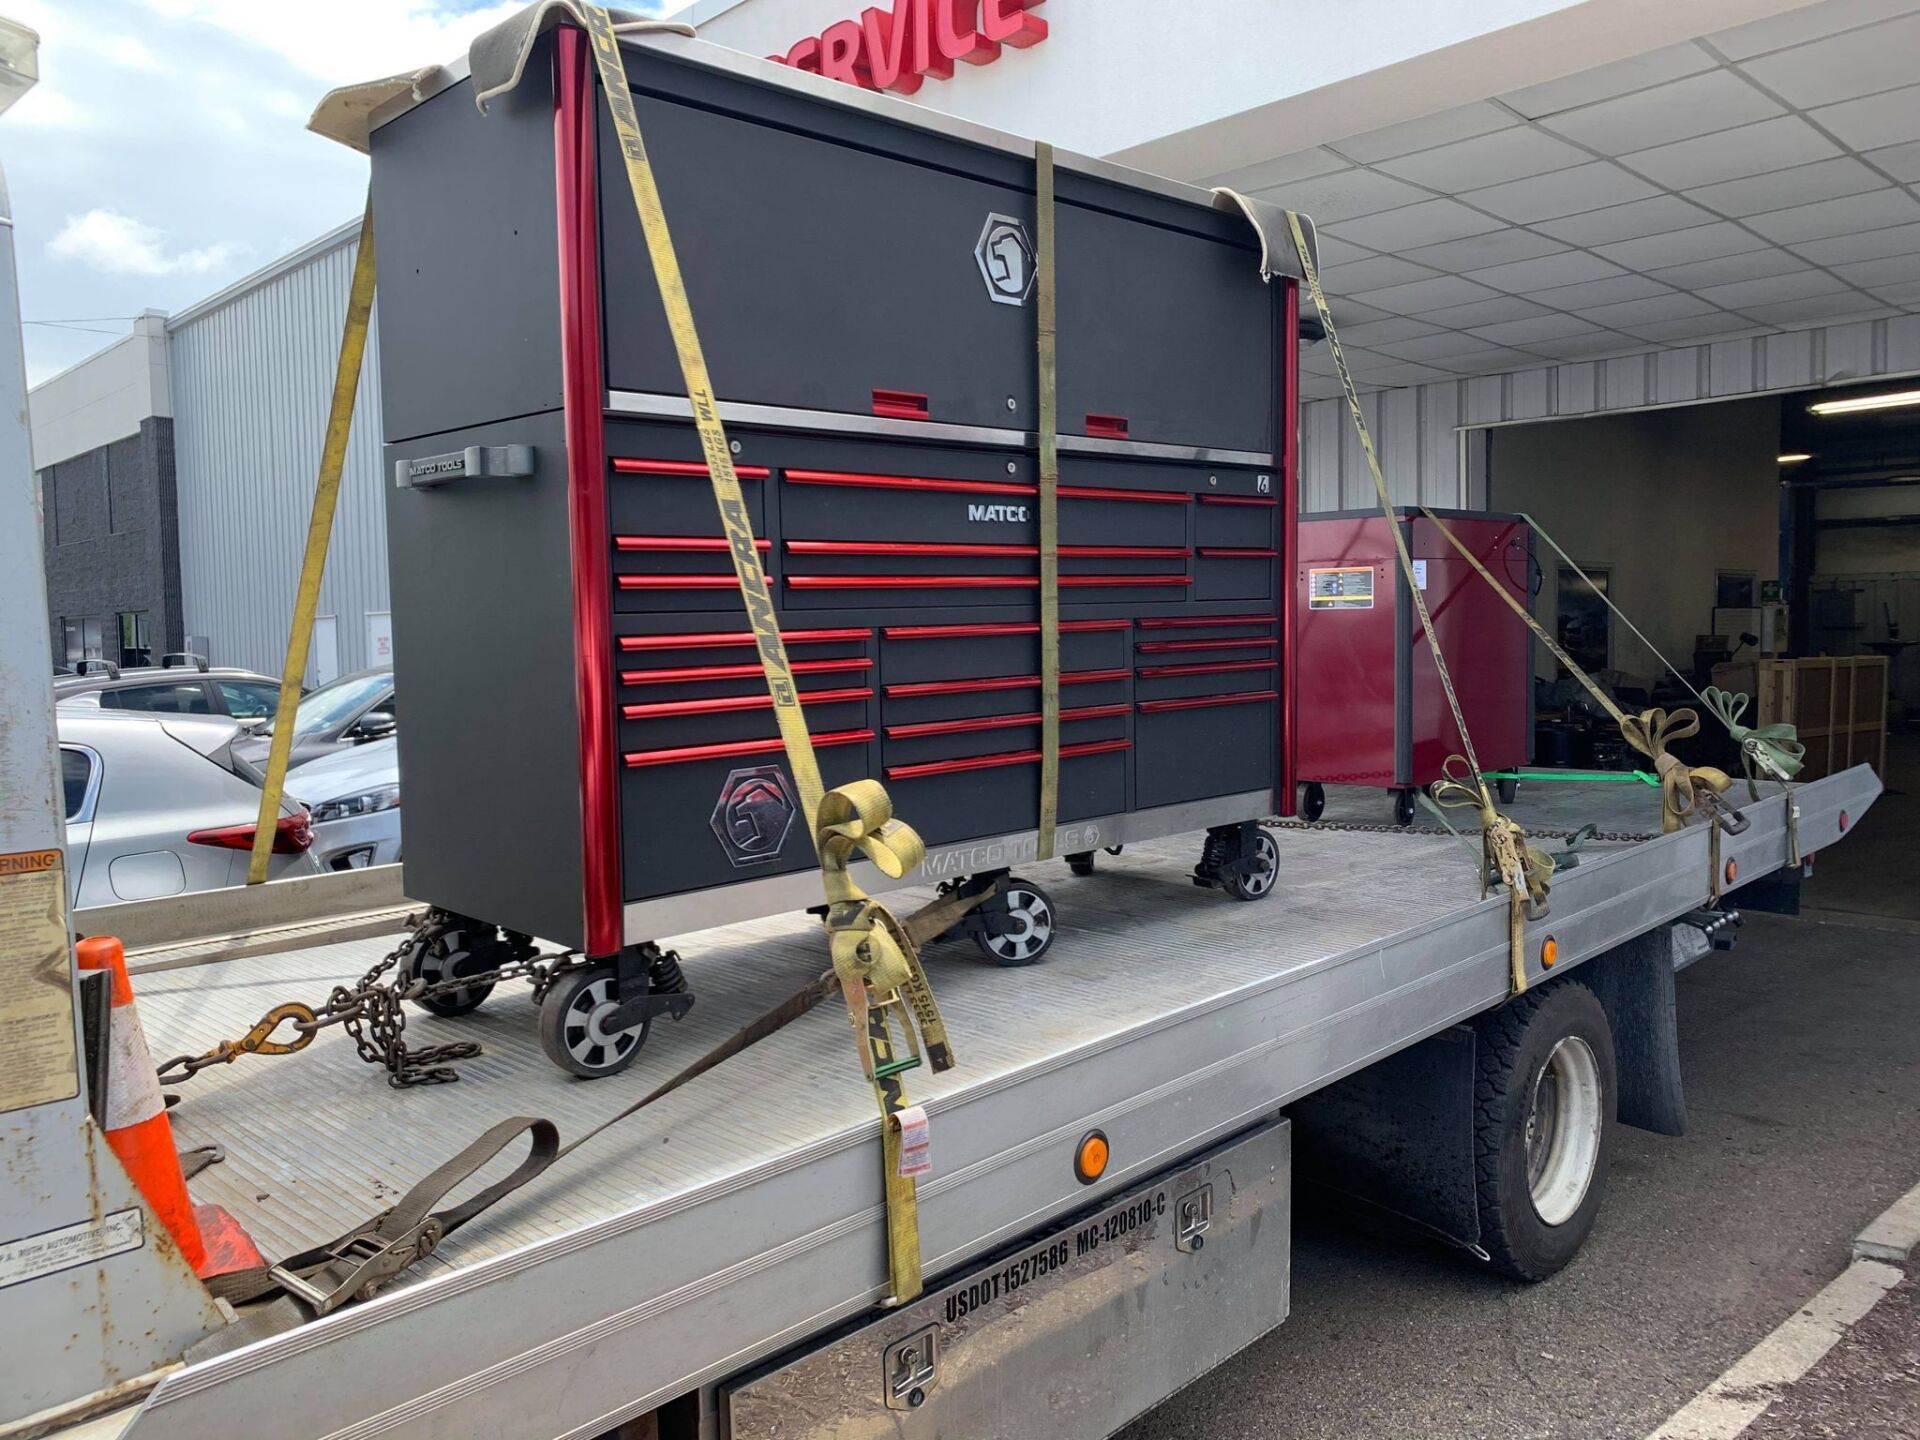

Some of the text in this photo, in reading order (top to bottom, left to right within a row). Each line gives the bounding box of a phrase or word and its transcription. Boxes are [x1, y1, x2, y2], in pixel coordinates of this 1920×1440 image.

[585, 5, 637, 131] ANCR
[765, 0, 1048, 95] ERVIC
[694, 389, 714, 421] WLL
[410, 459, 463, 477] MATCO TOOLS
[968, 504, 1030, 522] MATCO
[721, 499, 787, 673] ANCRA
[921, 828, 1079, 877] MATCO TOLS
[918, 995, 937, 1026] 1515
[1076, 1192, 1166, 1256] MC-120810-C
